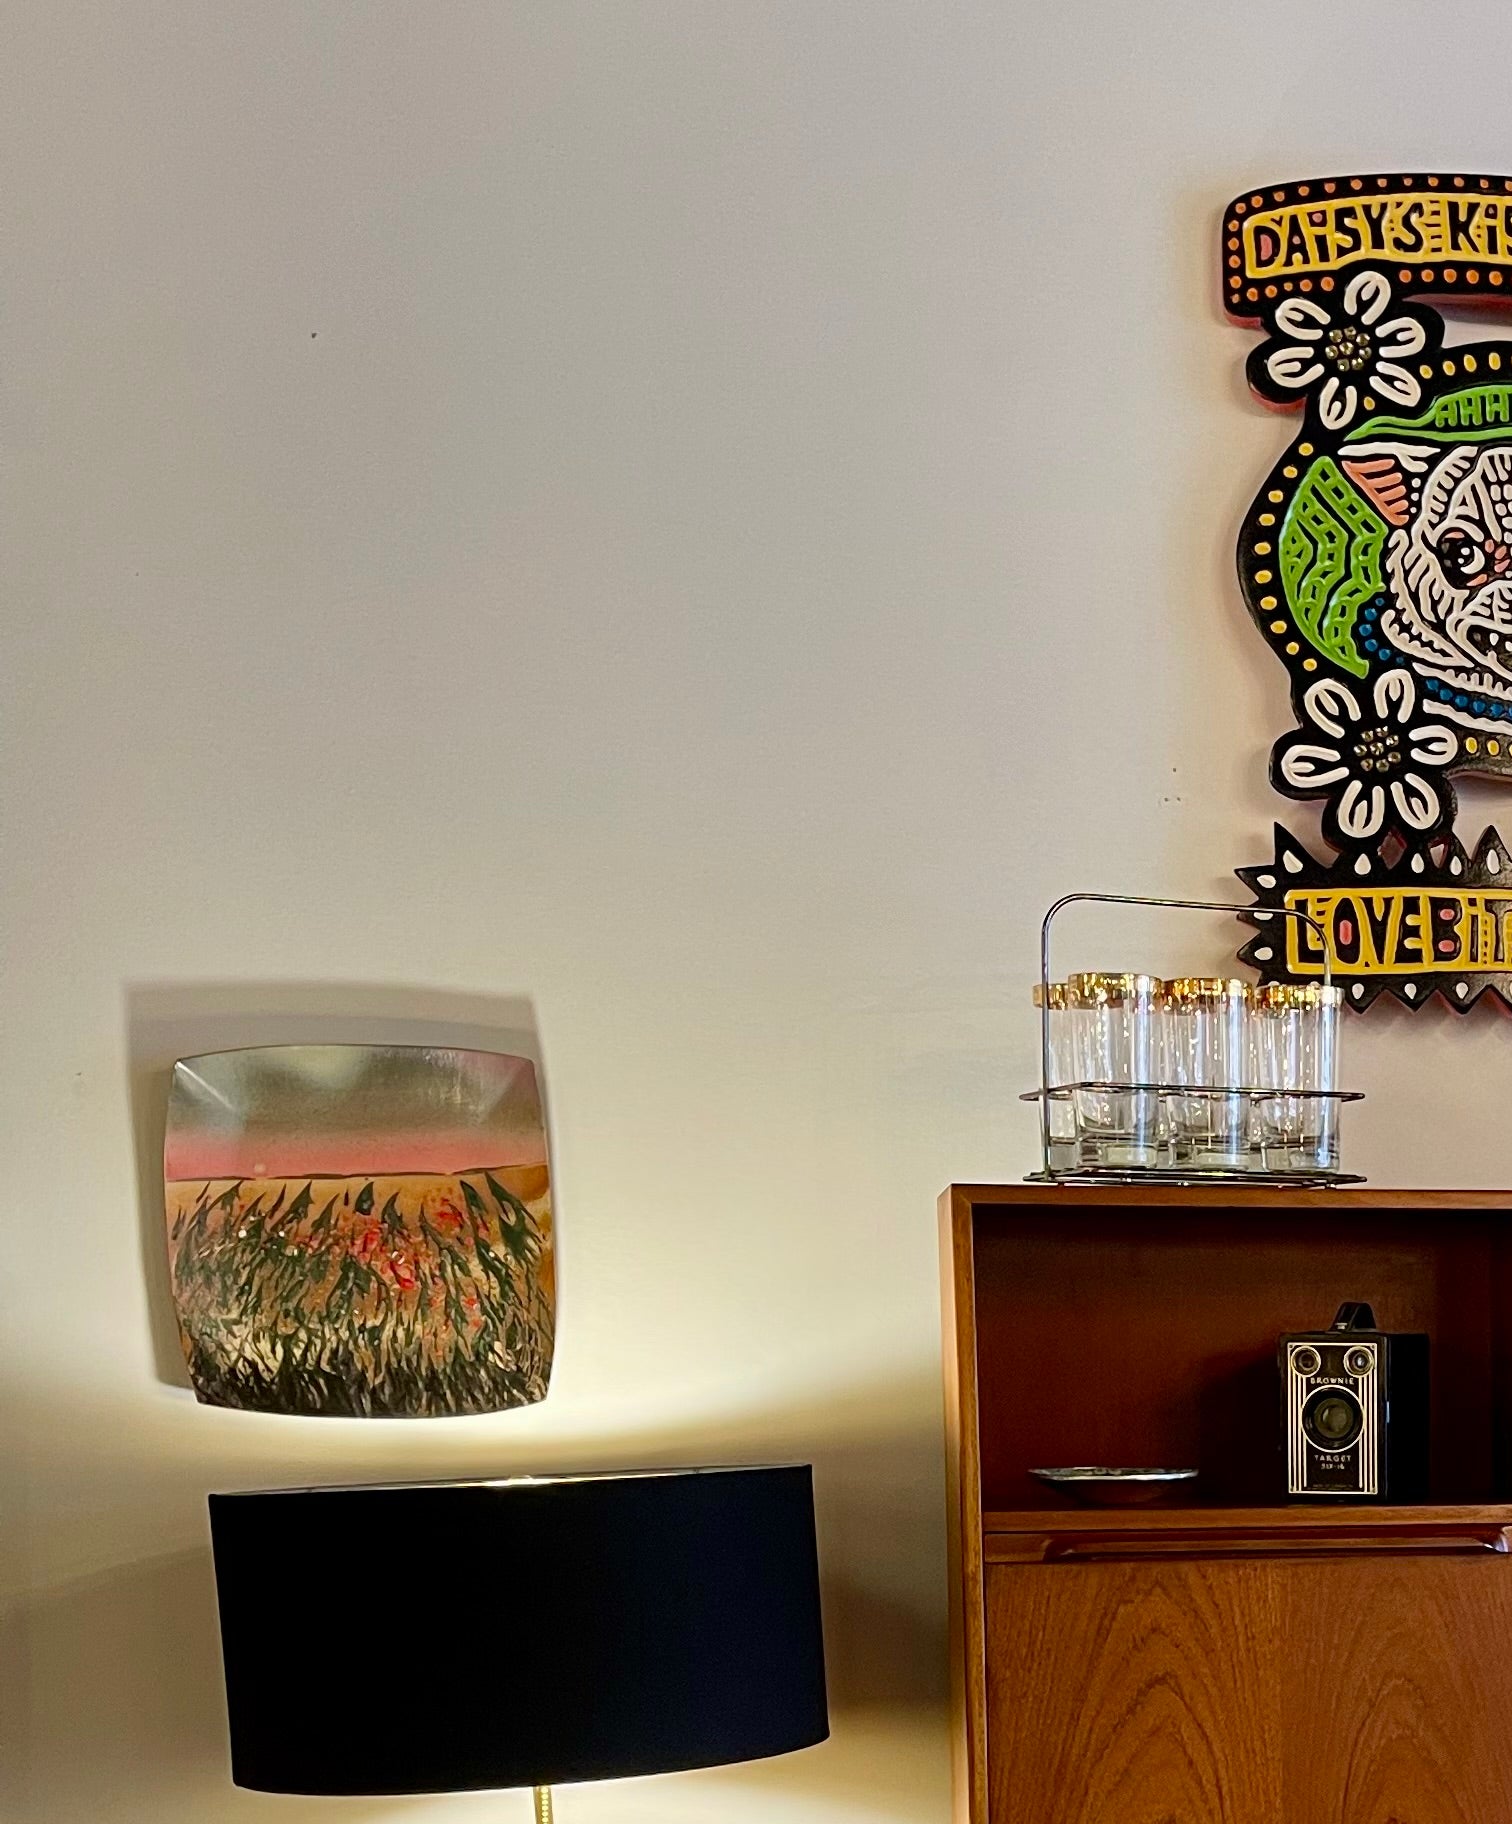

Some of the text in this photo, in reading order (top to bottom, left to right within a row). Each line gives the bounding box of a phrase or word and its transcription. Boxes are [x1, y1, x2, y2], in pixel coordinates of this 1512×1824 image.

[1294, 896, 1422, 966] LOVE
[1310, 1376, 1354, 1385] BROWNIE
[1314, 1454, 1351, 1463] TARGET
